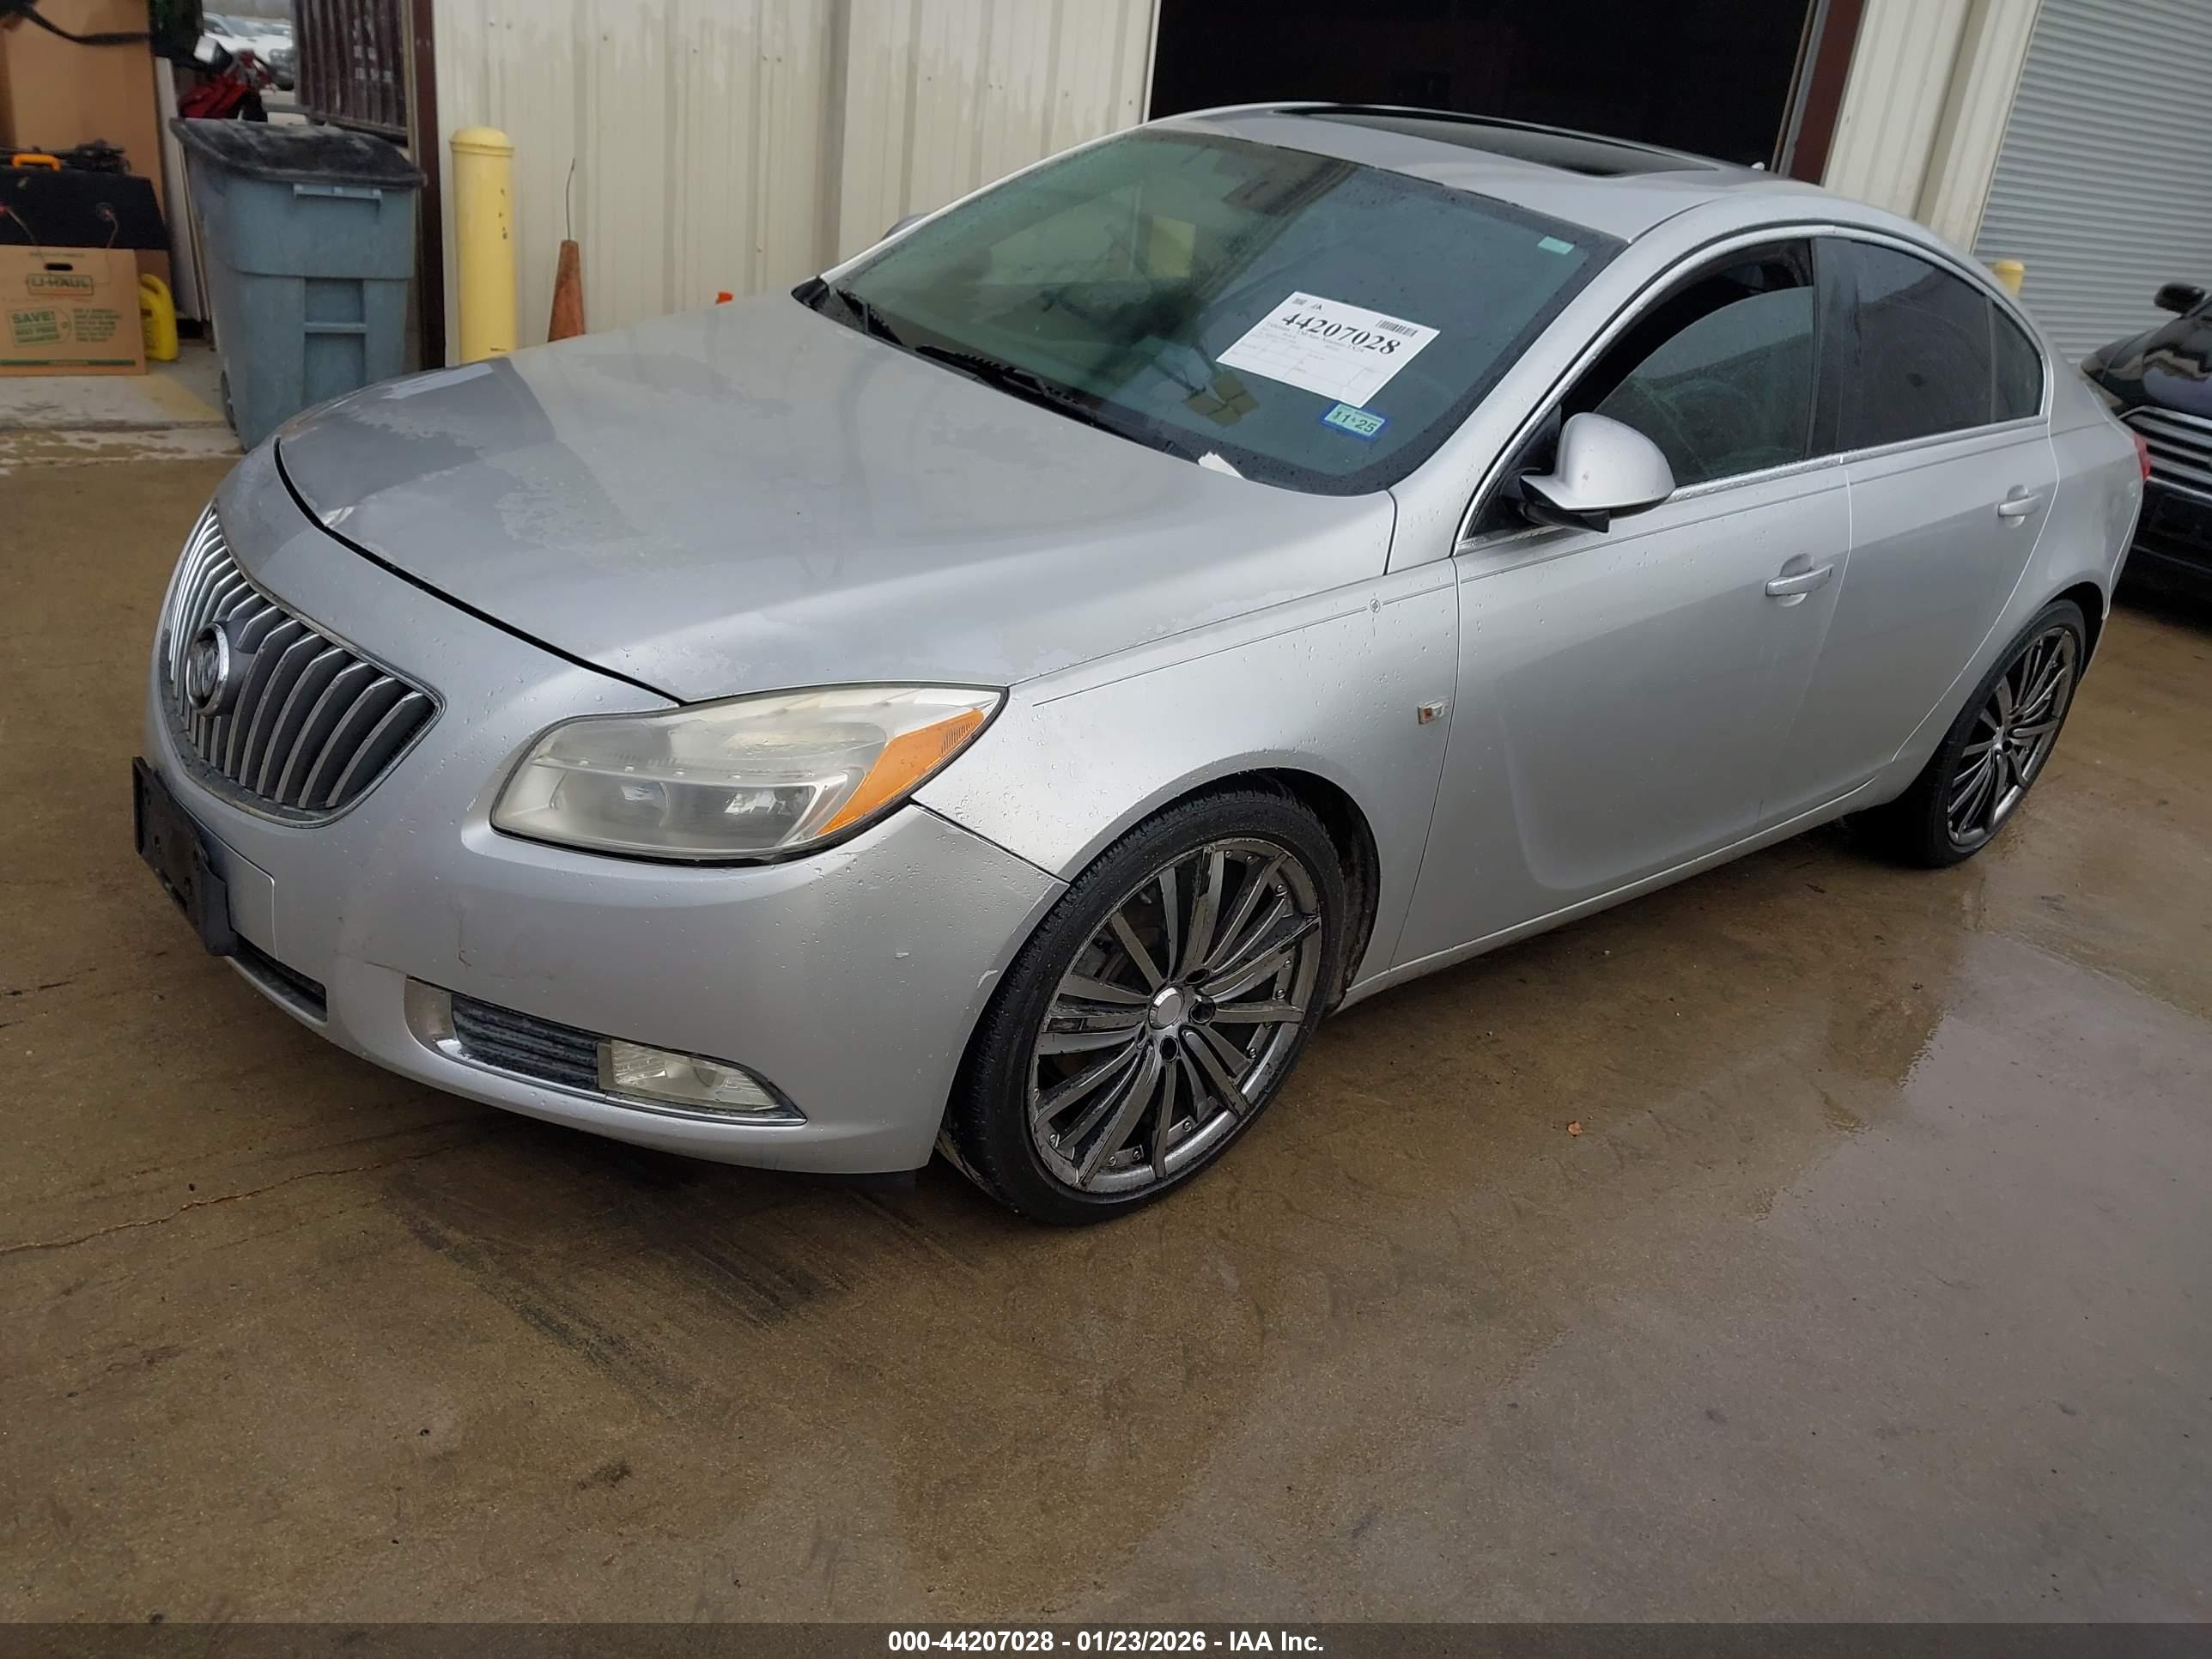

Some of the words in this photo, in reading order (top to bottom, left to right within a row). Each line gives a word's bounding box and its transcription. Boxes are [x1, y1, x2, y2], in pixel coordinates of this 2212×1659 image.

[32, 275, 90, 288] U-HAUL
[12, 310, 56, 324] SAVE!
[1282, 313, 1401, 356] 44207028
